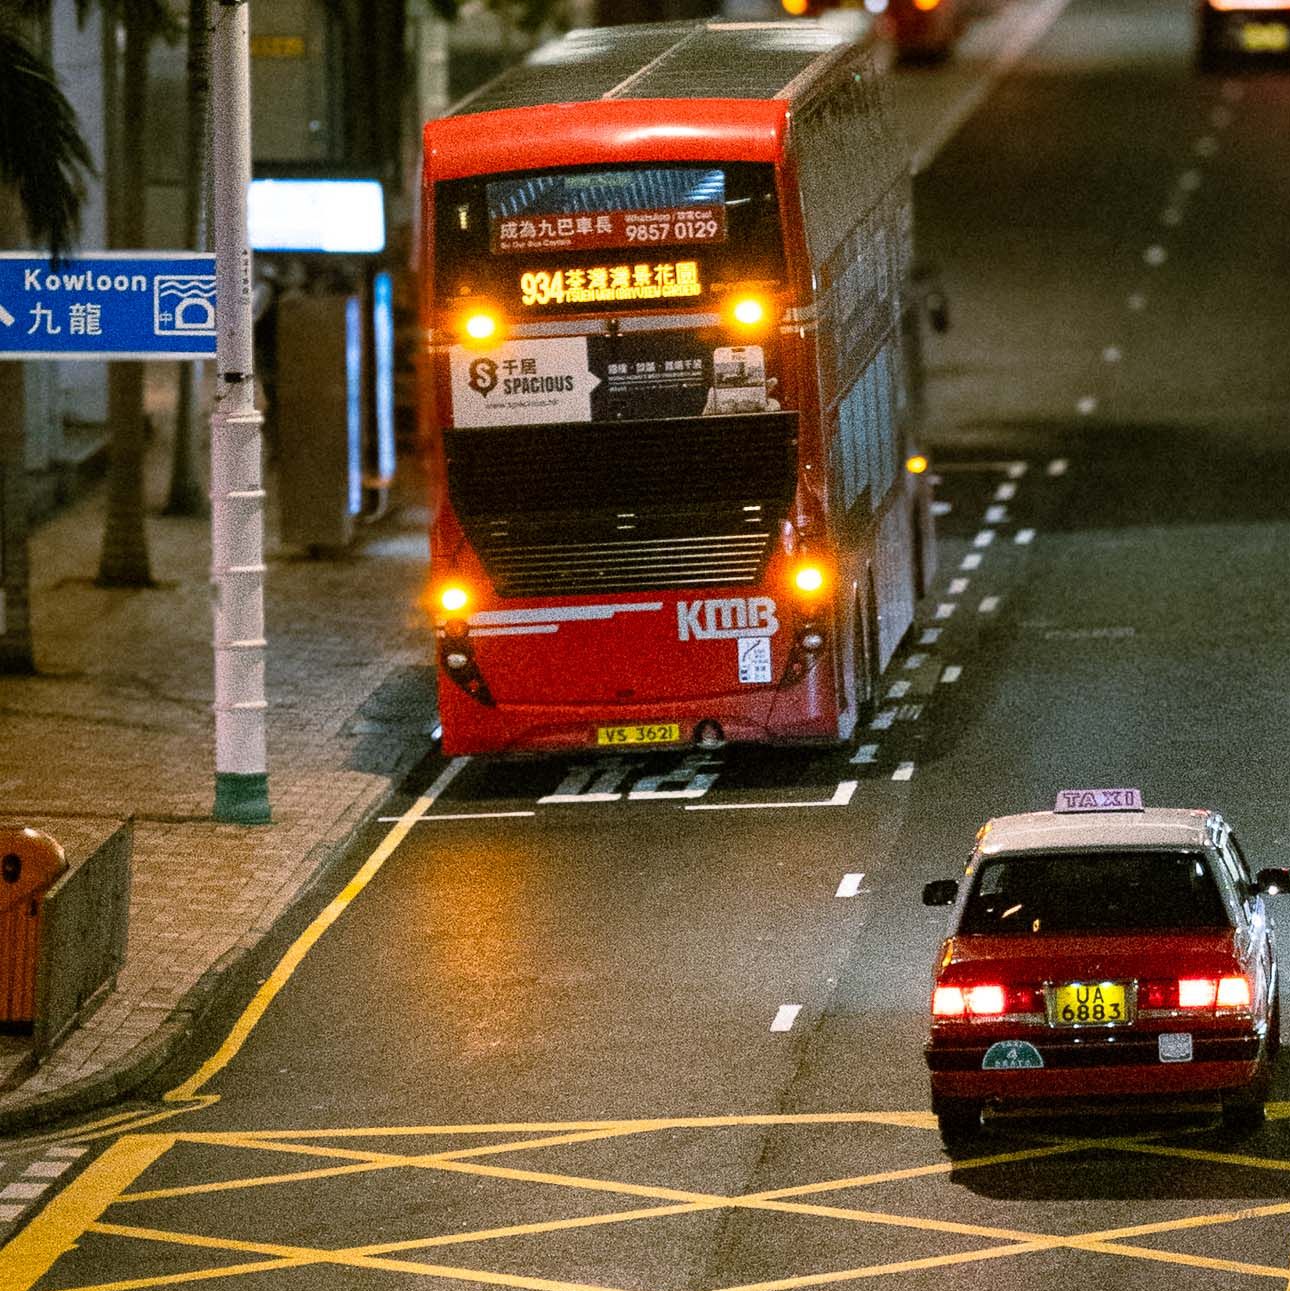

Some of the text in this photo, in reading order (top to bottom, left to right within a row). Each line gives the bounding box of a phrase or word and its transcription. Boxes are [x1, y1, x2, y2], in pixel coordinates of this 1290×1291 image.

[500, 215, 613, 239] 成為九巴車長
[626, 221, 718, 242] 9857 0129
[24, 269, 147, 292] Kowloon
[564, 261, 699, 289] 荃灣灣景花園
[520, 271, 564, 305] 934
[27, 301, 103, 335] 九龍
[159, 310, 173, 326] 中
[502, 358, 537, 375] 千居
[503, 375, 574, 394] SPACIOUS
[677, 596, 780, 641] KMB
[605, 726, 673, 742] VS 3621
[1063, 791, 1135, 808] TAXI
[1076, 987, 1104, 1004] UA
[1062, 1003, 1121, 1021] 6883
